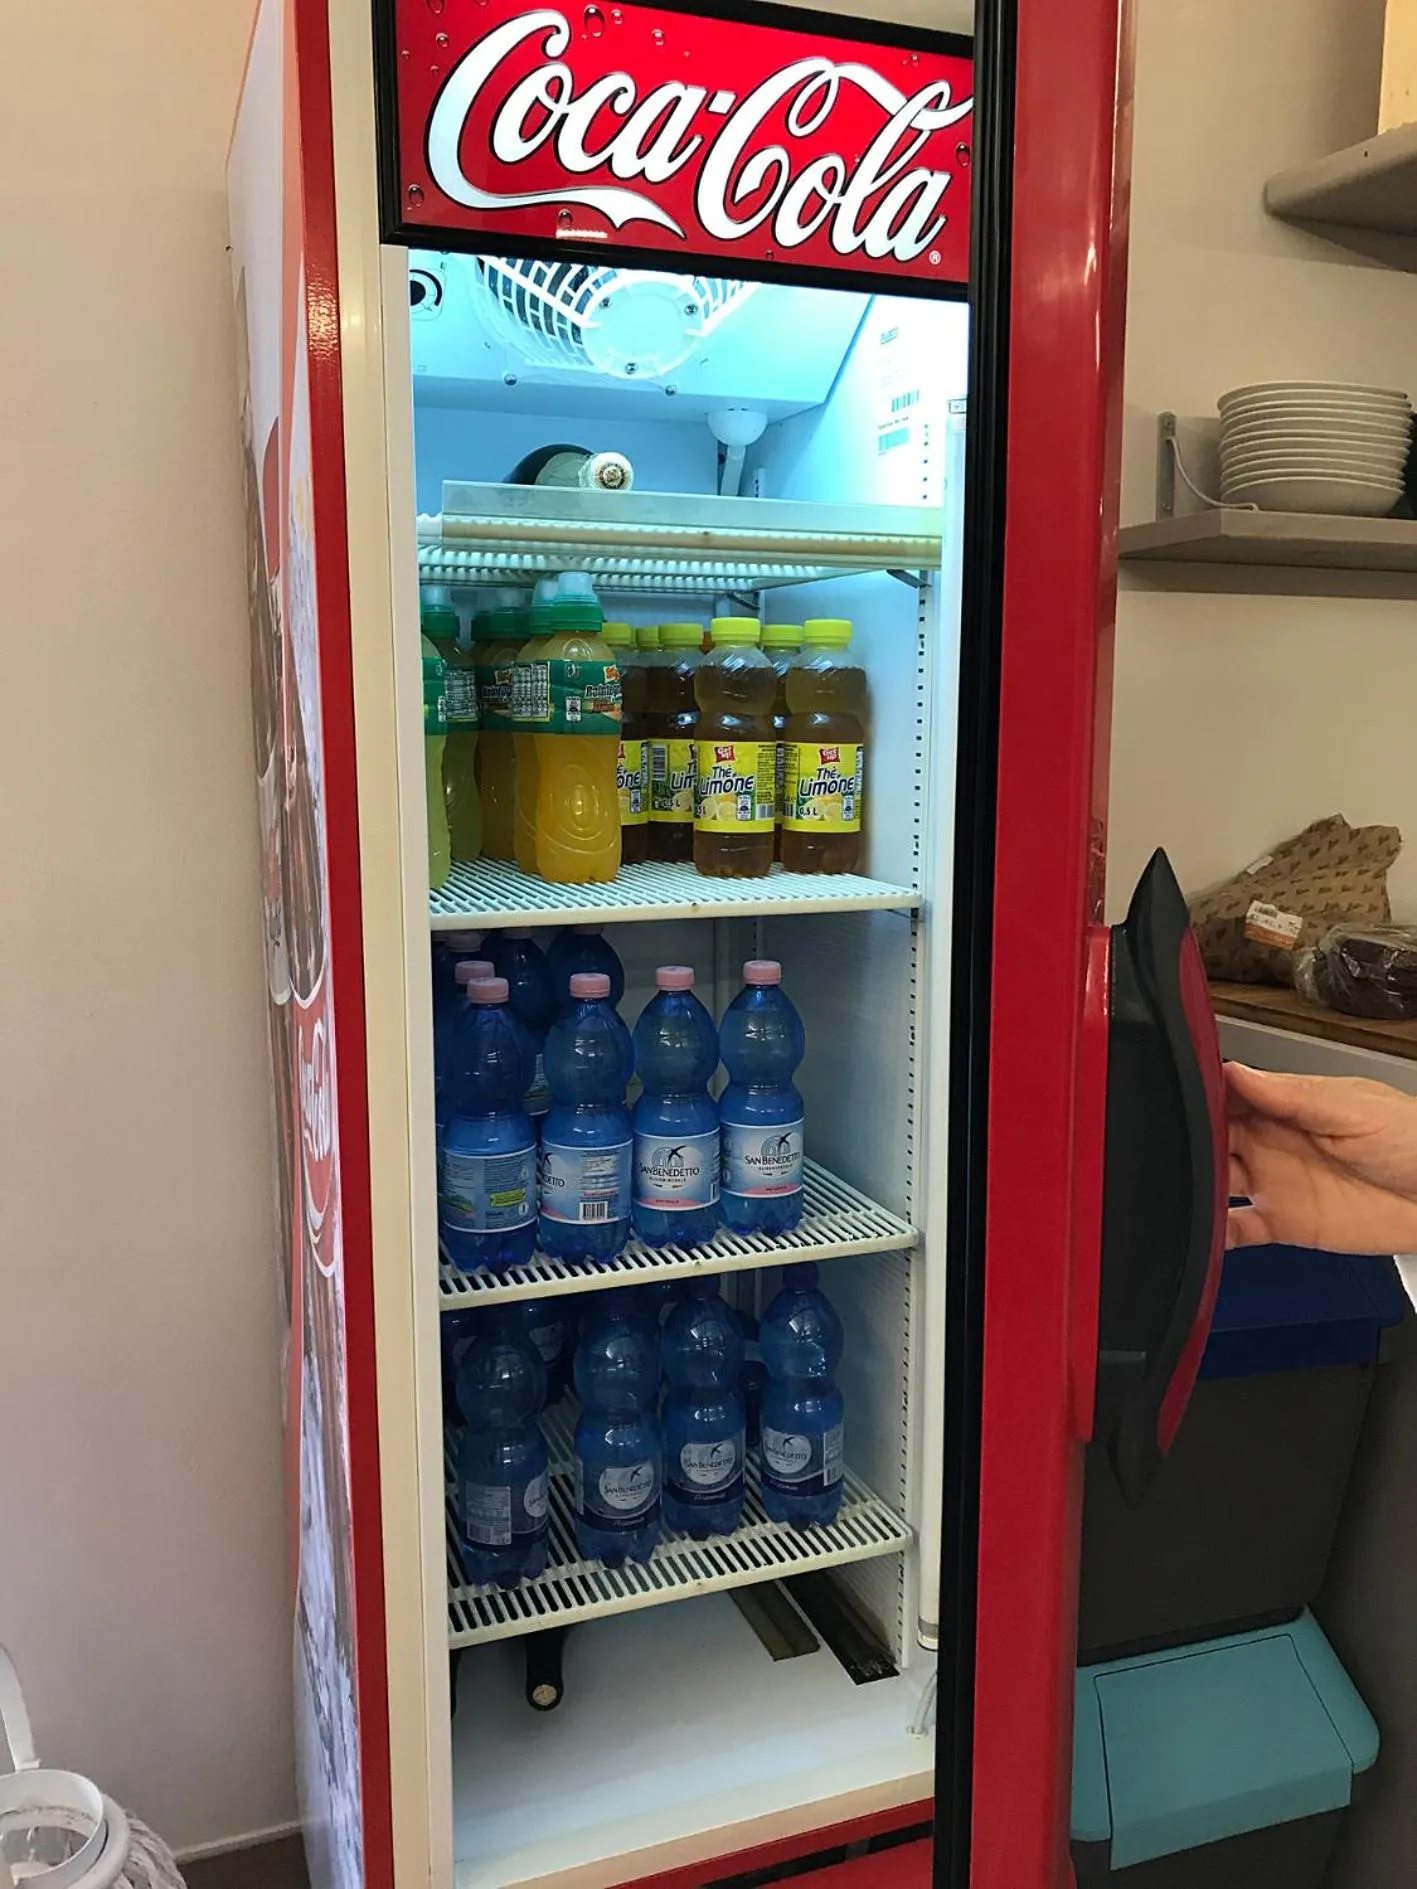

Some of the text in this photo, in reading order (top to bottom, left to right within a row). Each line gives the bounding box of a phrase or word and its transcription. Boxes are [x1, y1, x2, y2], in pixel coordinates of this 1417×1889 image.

[425, 8, 972, 262] Coca-Cola
[616, 771, 641, 788] one
[671, 772, 695, 791] Lim
